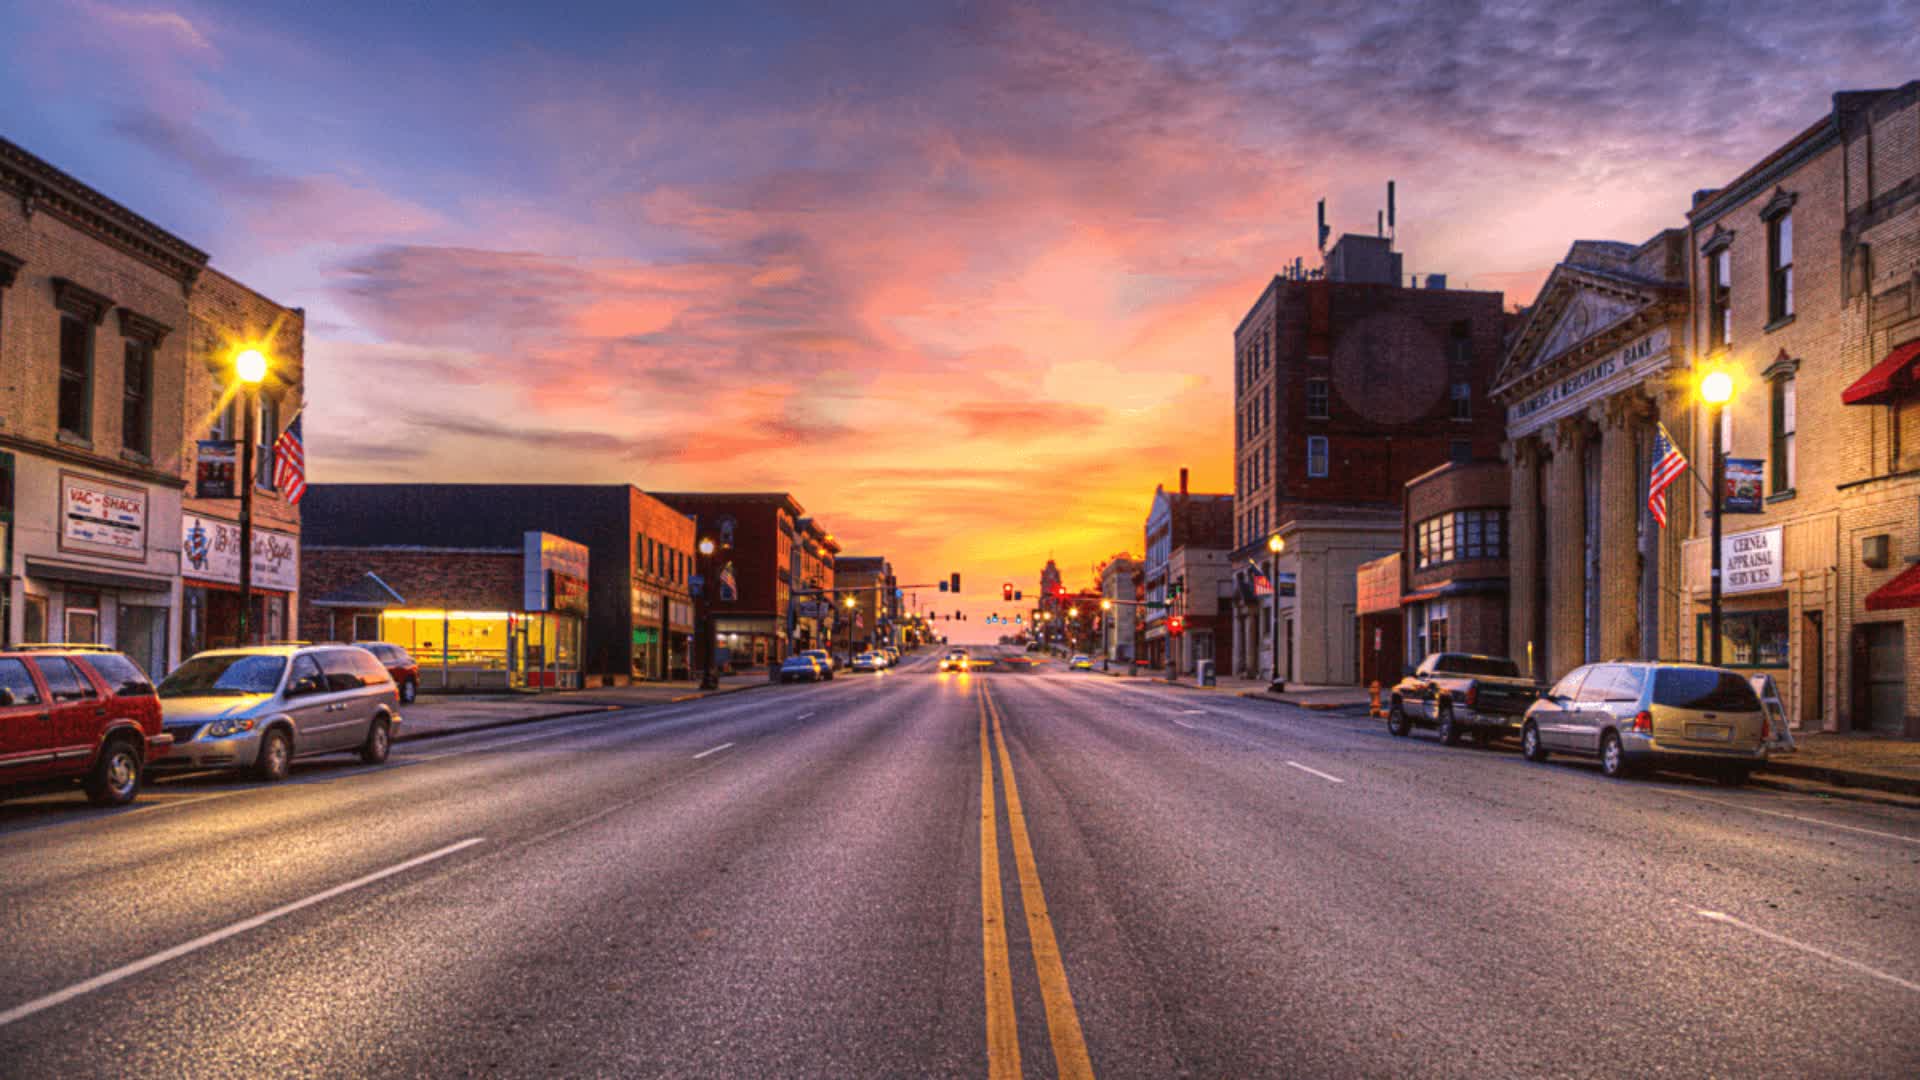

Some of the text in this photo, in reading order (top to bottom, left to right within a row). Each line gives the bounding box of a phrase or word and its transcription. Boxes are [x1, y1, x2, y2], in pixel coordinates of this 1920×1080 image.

[1561, 357, 1617, 397] MERCHANTS
[1623, 337, 1652, 366] BANK
[1733, 535, 1768, 552] CERNEA
[1727, 551, 1773, 570] APPRAISAL
[1728, 568, 1770, 586] SERVICES
